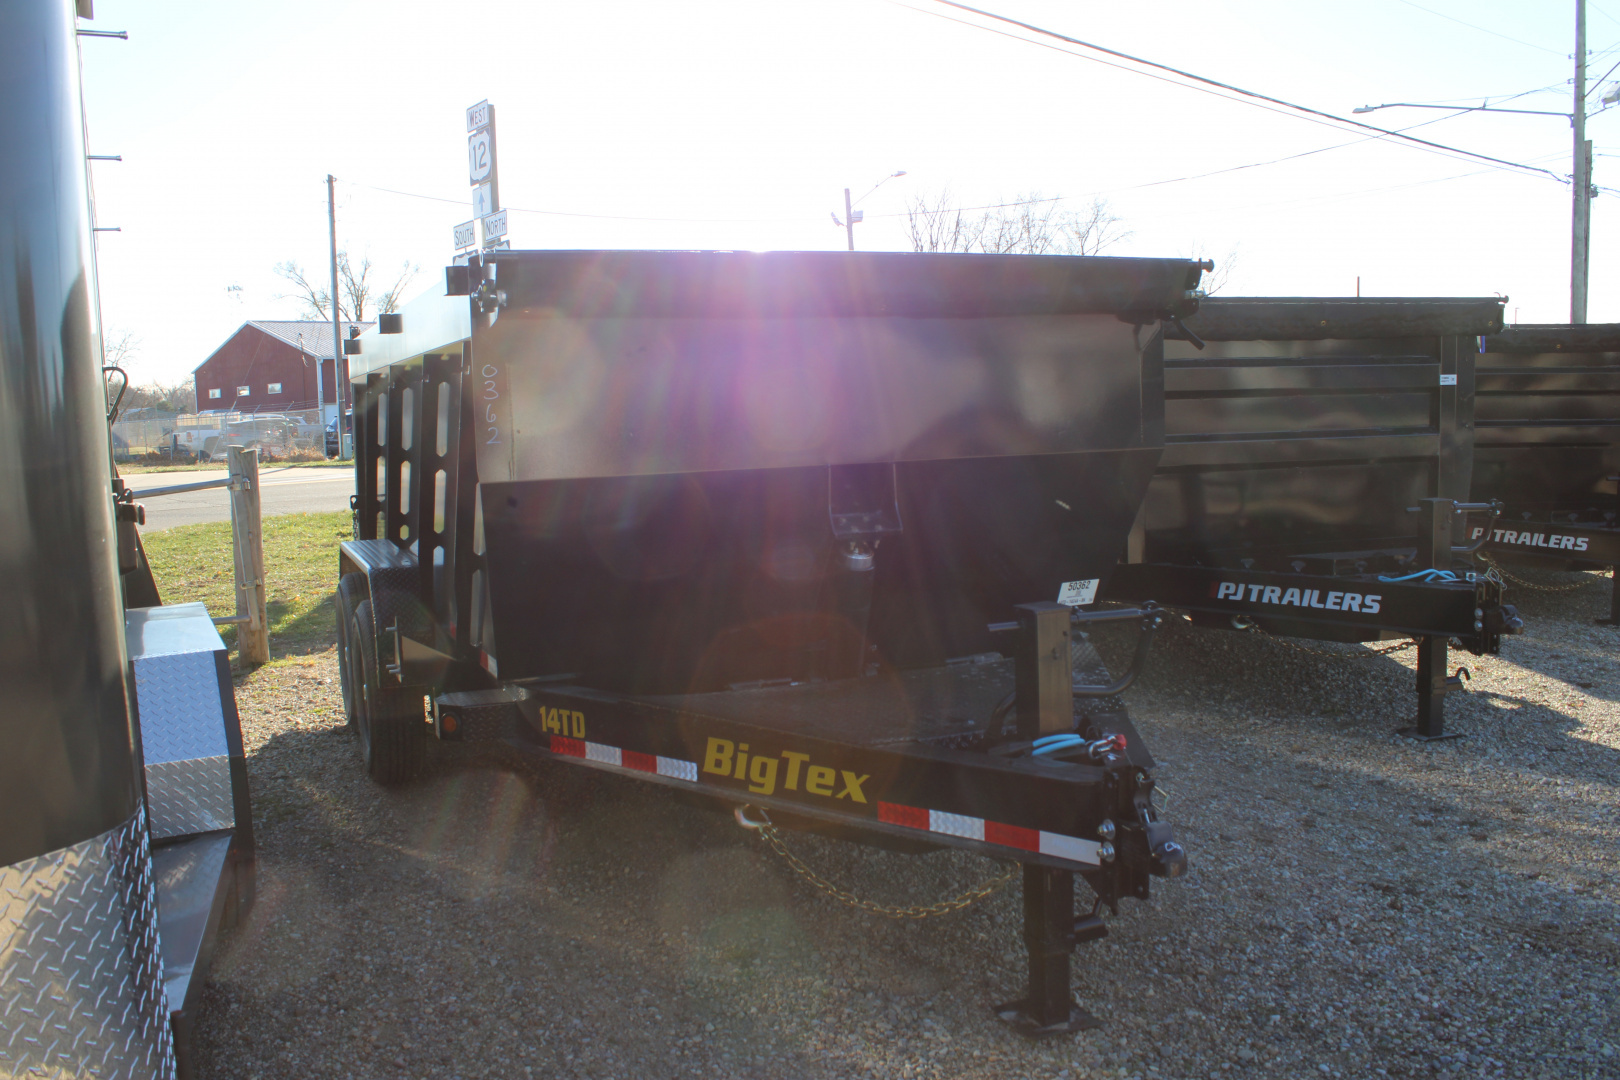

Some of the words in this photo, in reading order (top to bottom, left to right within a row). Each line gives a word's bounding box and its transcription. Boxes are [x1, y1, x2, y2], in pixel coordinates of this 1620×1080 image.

[468, 106, 487, 127] WEST
[472, 140, 488, 172] 12
[454, 227, 475, 246] SOUTH
[485, 217, 507, 238] NORTH
[1493, 528, 1590, 552] TRAILERS
[1067, 580, 1091, 592] 50362
[1216, 581, 1247, 602] PJ
[1247, 584, 1383, 614] TRAILERS
[539, 705, 586, 740] 14TD
